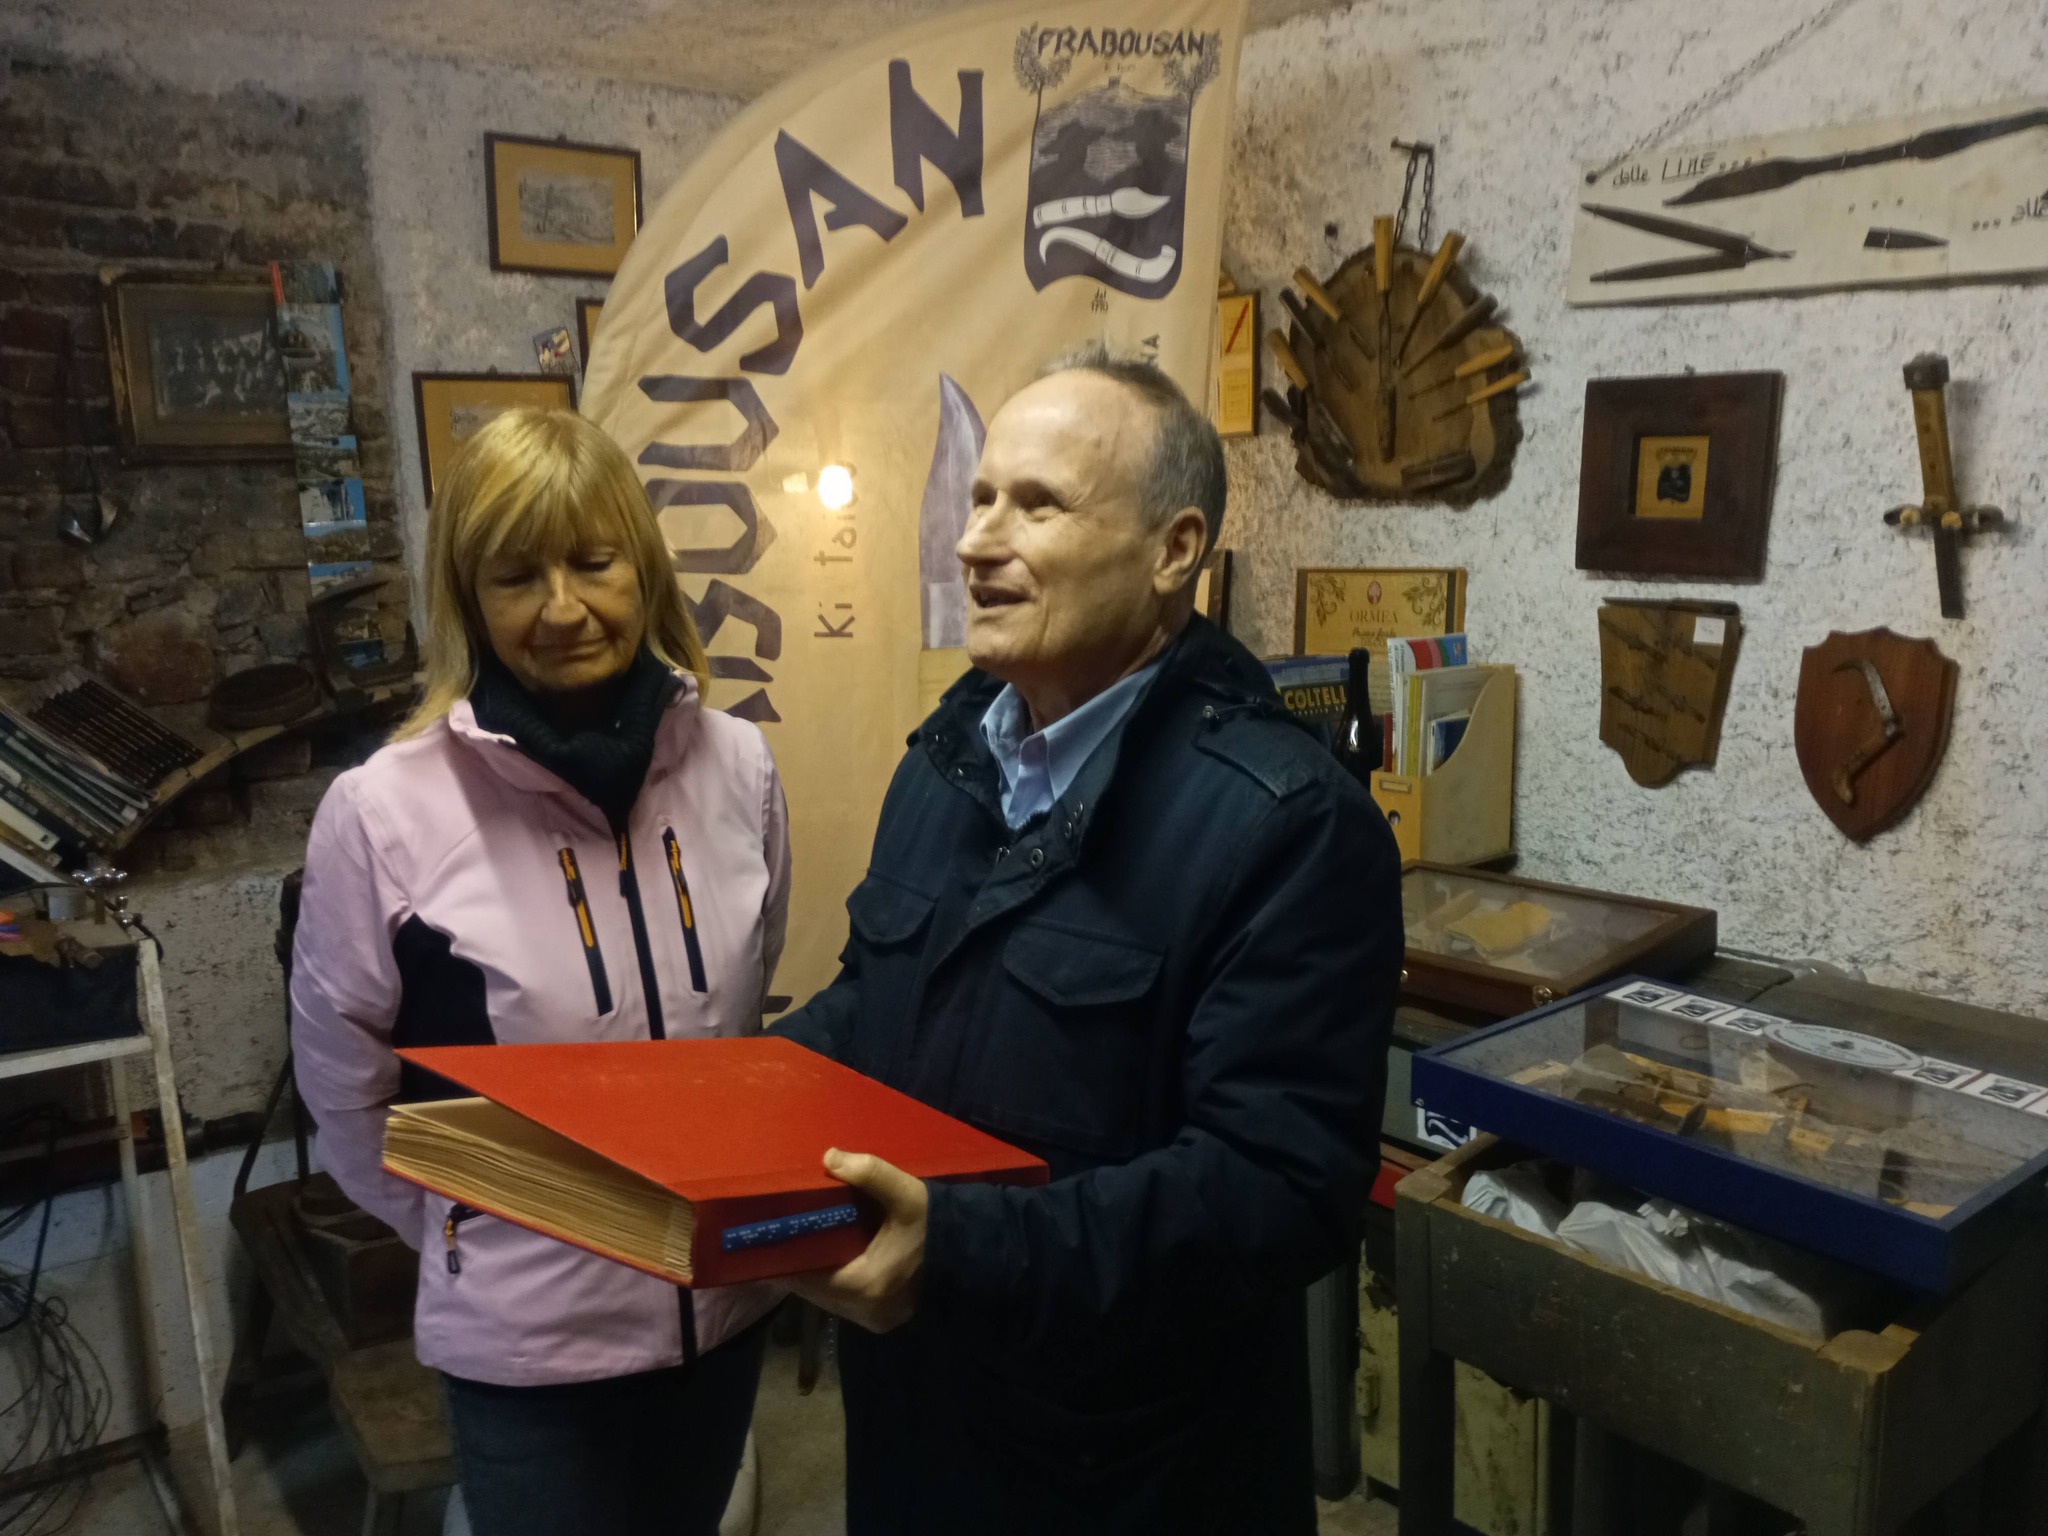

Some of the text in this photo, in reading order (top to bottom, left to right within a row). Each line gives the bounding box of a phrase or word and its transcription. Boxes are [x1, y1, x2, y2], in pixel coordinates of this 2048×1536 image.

[1037, 25, 1205, 58] FRABOUSAN
[636, 58, 984, 724] BOUSAN
[814, 603, 856, 638] Ki
[1349, 609, 1398, 624] ORMEA
